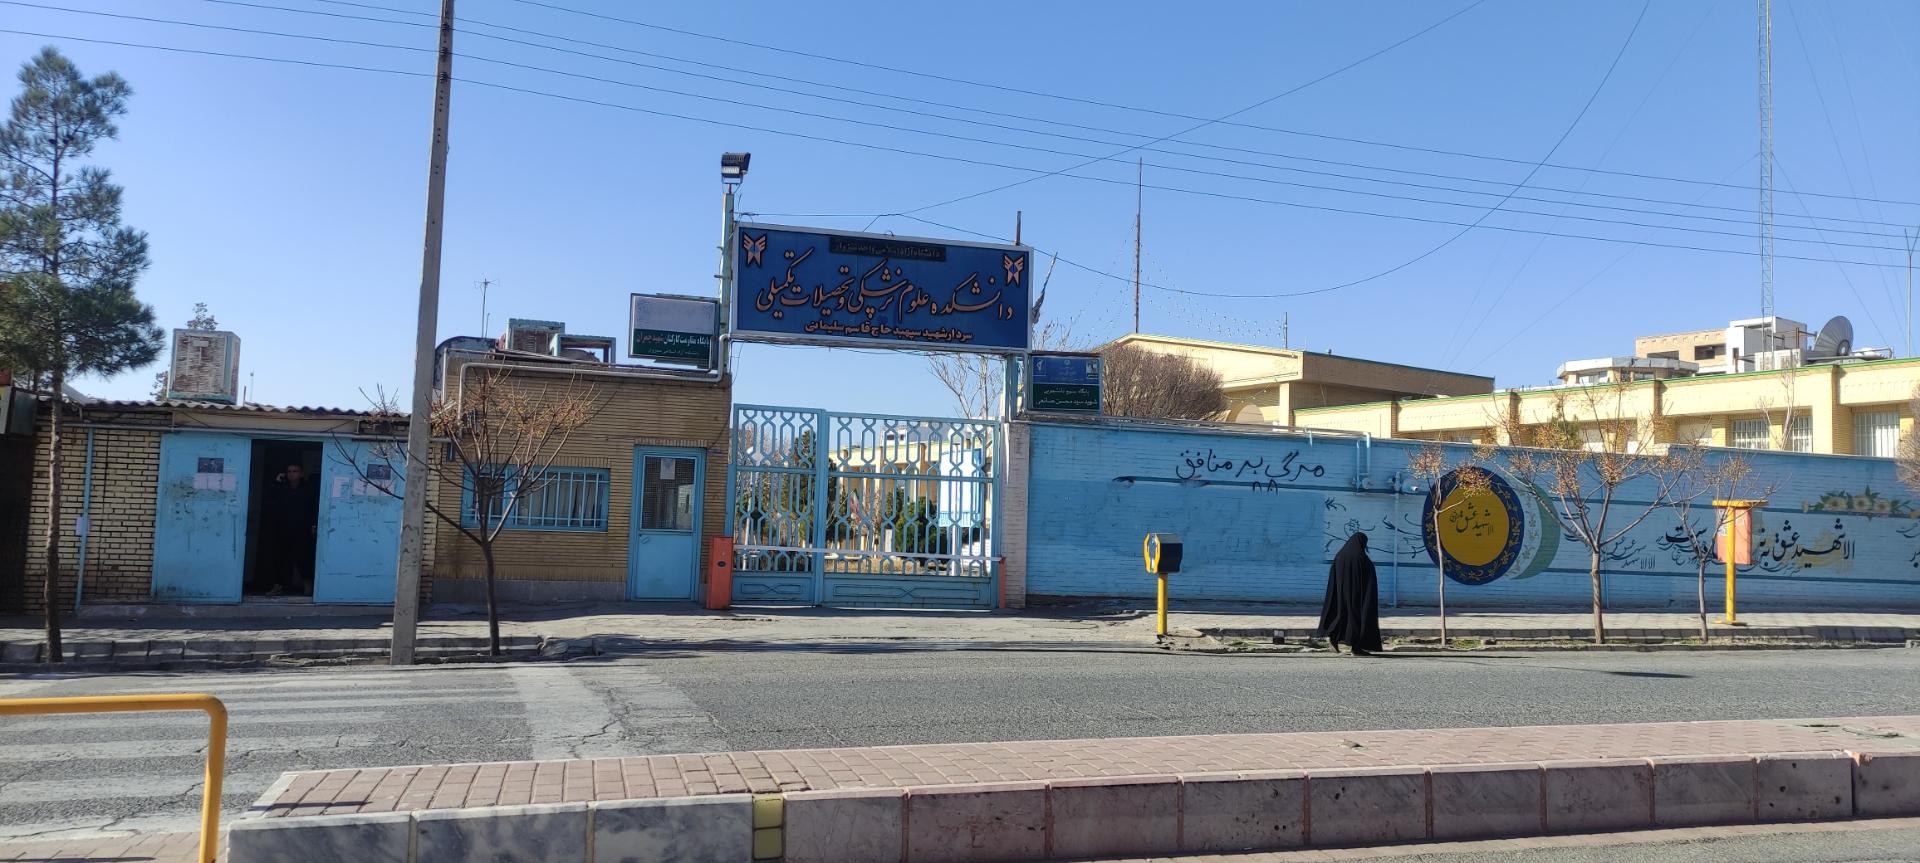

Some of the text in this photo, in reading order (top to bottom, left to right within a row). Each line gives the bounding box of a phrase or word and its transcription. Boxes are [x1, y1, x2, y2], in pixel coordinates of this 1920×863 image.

[754, 245, 816, 319] تکمیلی
[779, 264, 856, 318] تحصیلات
[846, 256, 908, 320] پزشکی
[930, 271, 1014, 321] دانشکده
[833, 295, 846, 312] و
[898, 284, 930, 323] علوم
[805, 319, 845, 333] سلیمانی
[845, 320, 871, 335] قاسم
[871, 323, 892, 337] حاج
[893, 325, 922, 339] سپهبد
[922, 326, 947, 339] شهید
[1175, 449, 1325, 482] مرگ بر منافق
[1772, 519, 1801, 562] عشق
